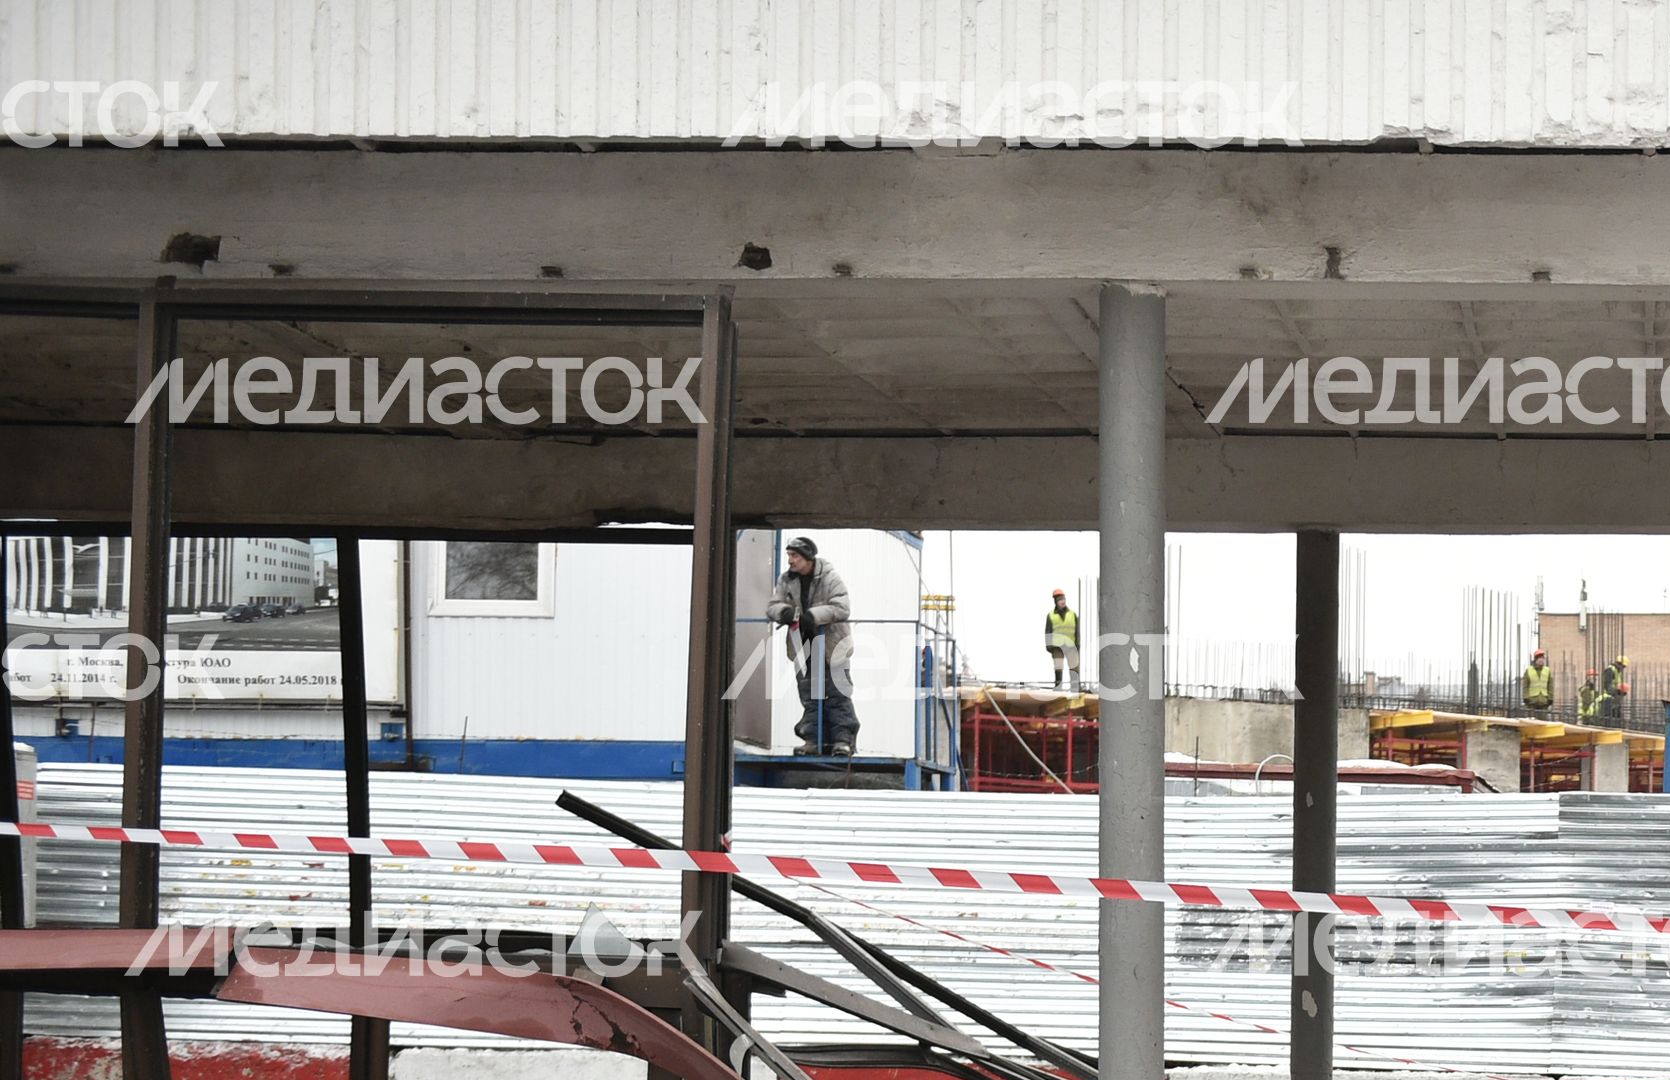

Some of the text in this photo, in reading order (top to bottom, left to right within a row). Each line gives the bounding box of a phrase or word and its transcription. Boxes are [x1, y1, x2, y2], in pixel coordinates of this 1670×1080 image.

[201, 657, 231, 668] ЮАО
[8, 673, 31, 682] абот
[178, 674, 240, 685] Окончание
[244, 675, 275, 687] работ
[280, 675, 337, 685] 24.05.2018
